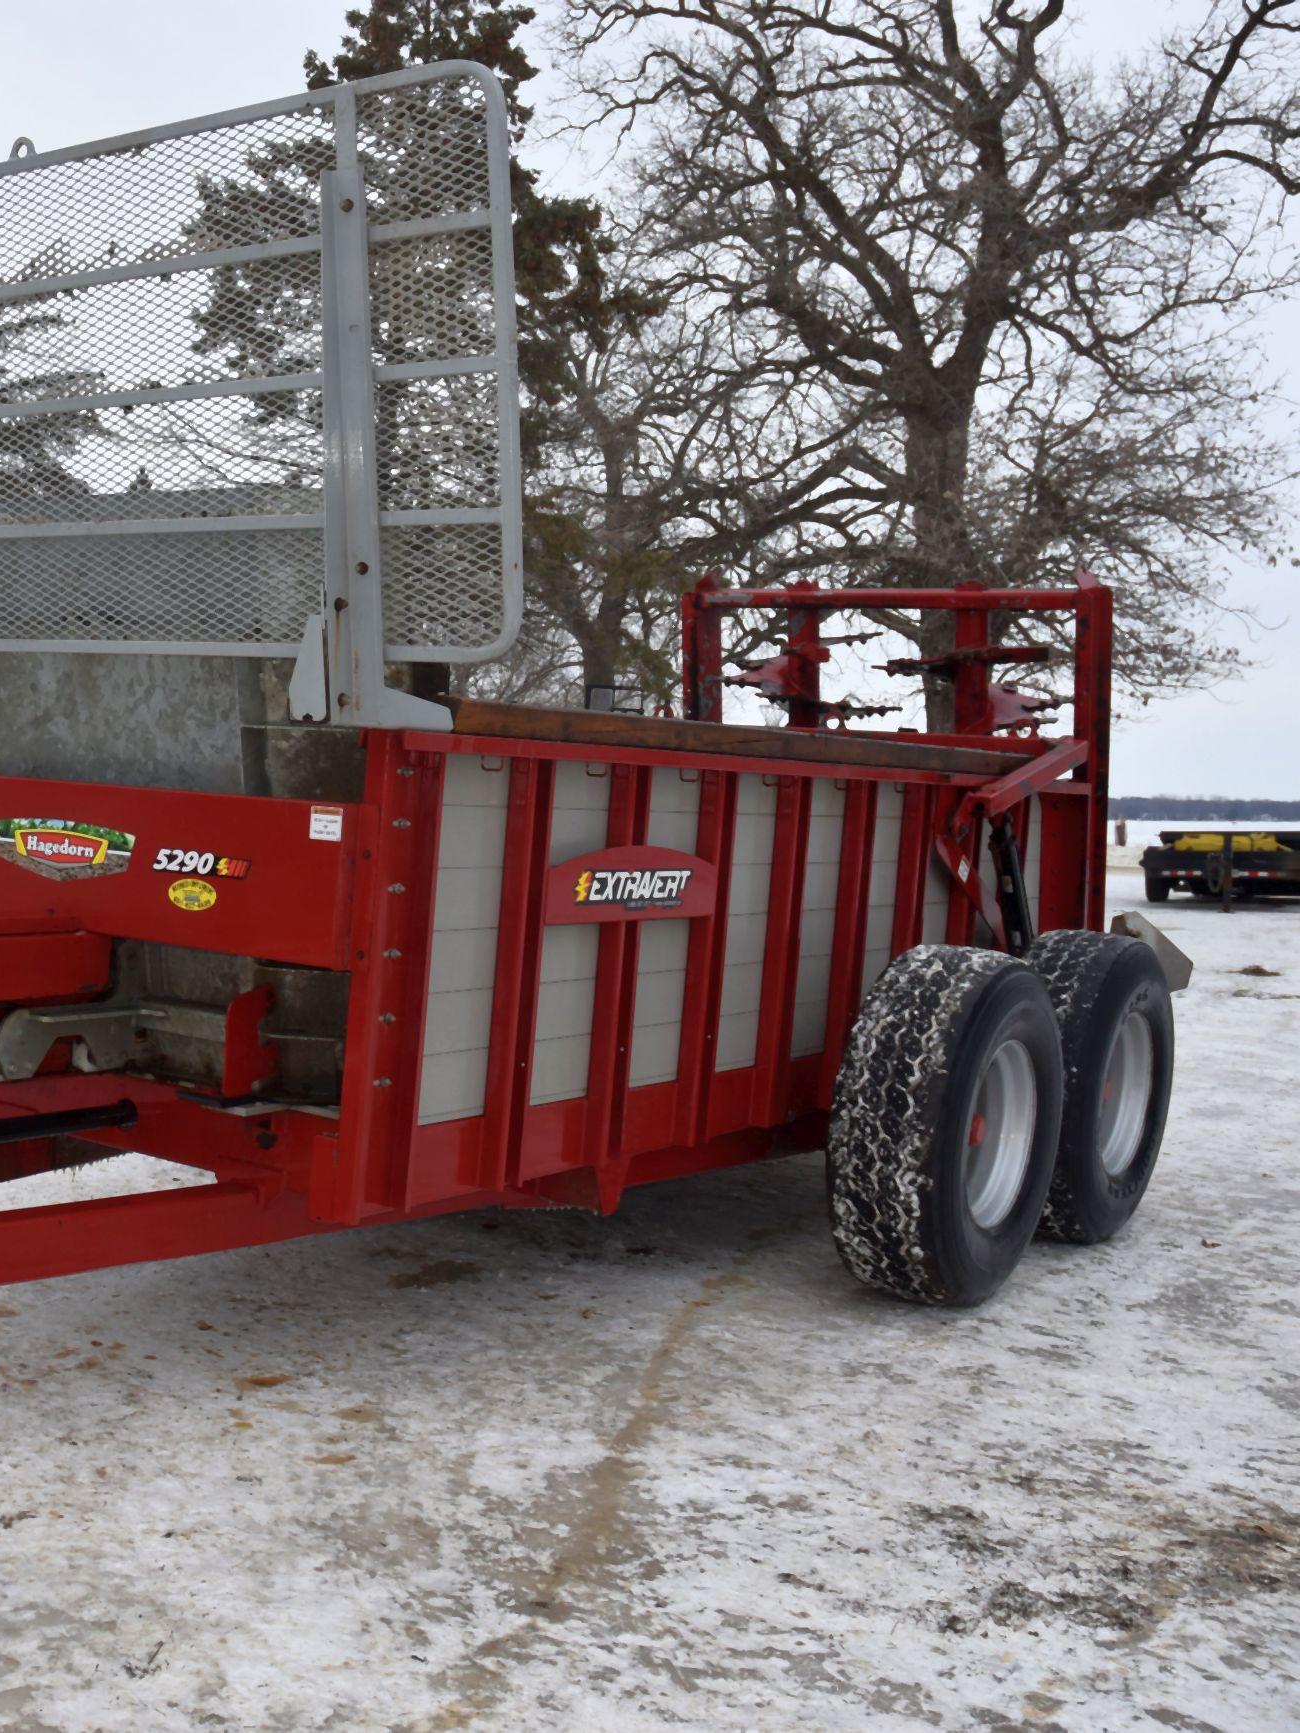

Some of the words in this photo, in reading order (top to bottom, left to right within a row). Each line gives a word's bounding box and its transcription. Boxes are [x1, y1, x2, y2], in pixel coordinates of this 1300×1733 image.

[26, 834, 94, 859] Hagedorn
[152, 848, 215, 875] 5290
[589, 870, 691, 901] EXTRAVERT
